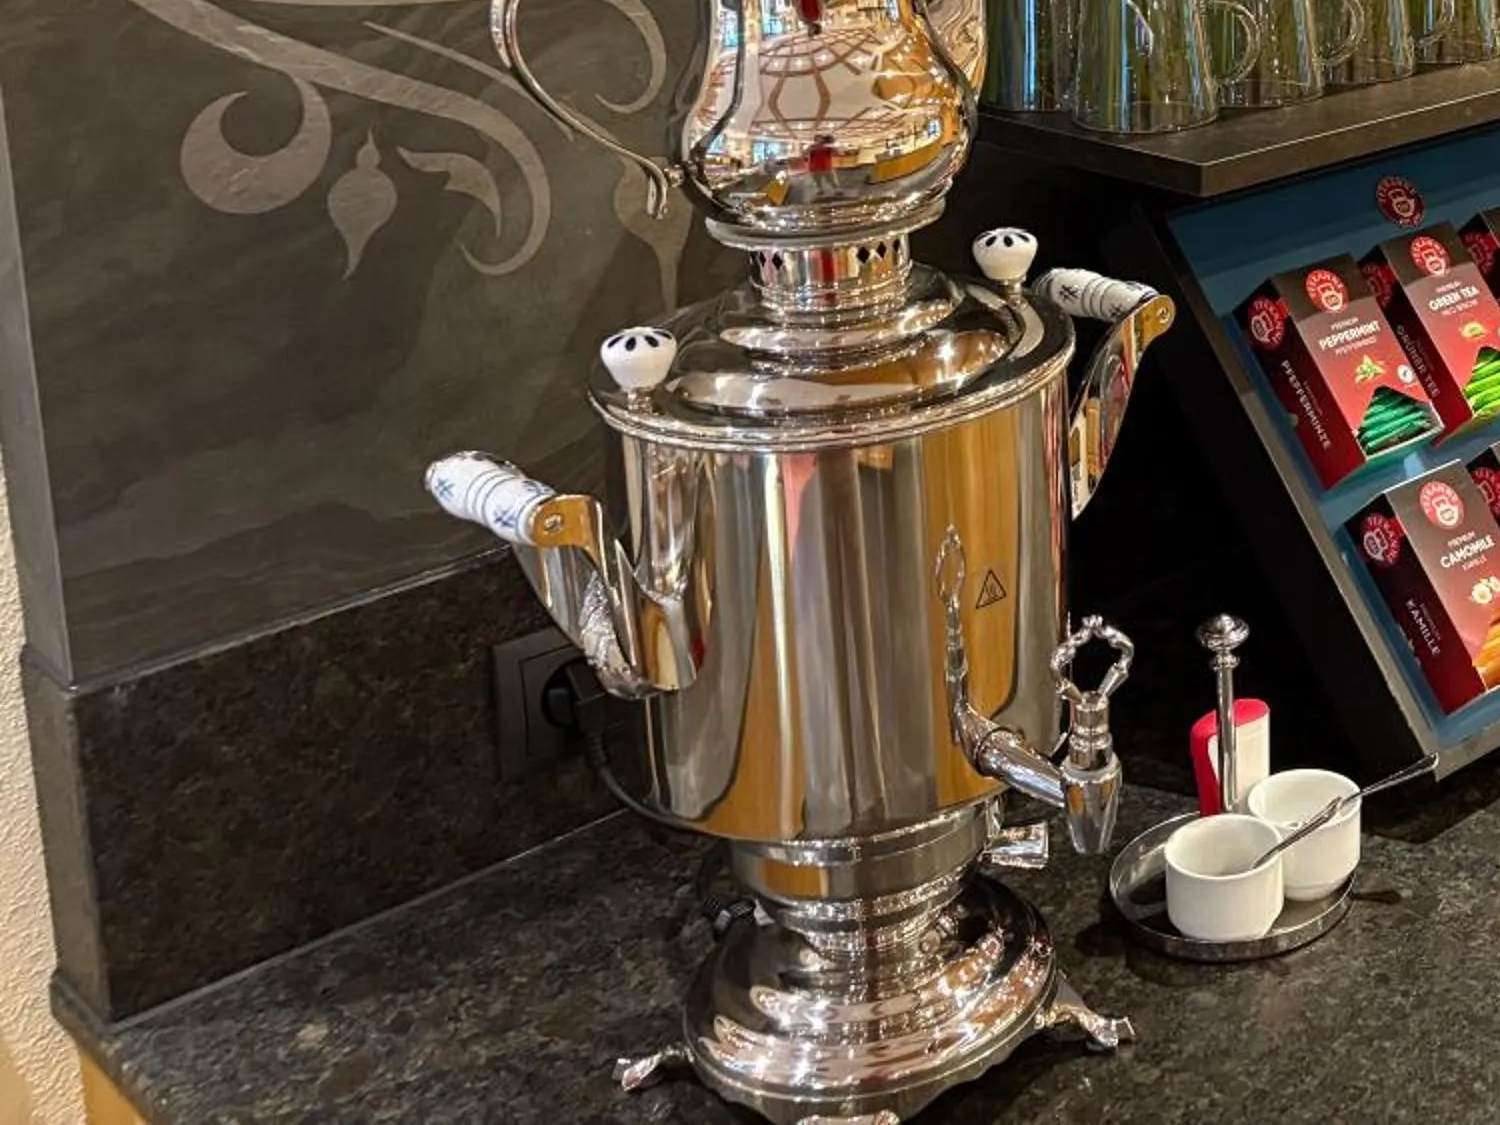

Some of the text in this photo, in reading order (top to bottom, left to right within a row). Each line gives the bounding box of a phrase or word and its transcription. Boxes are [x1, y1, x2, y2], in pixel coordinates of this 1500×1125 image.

[1318, 320, 1381, 351] PEPPERMINT
[1440, 534, 1495, 568] CAMOMILE
[1405, 598, 1441, 657] KAMILLE
